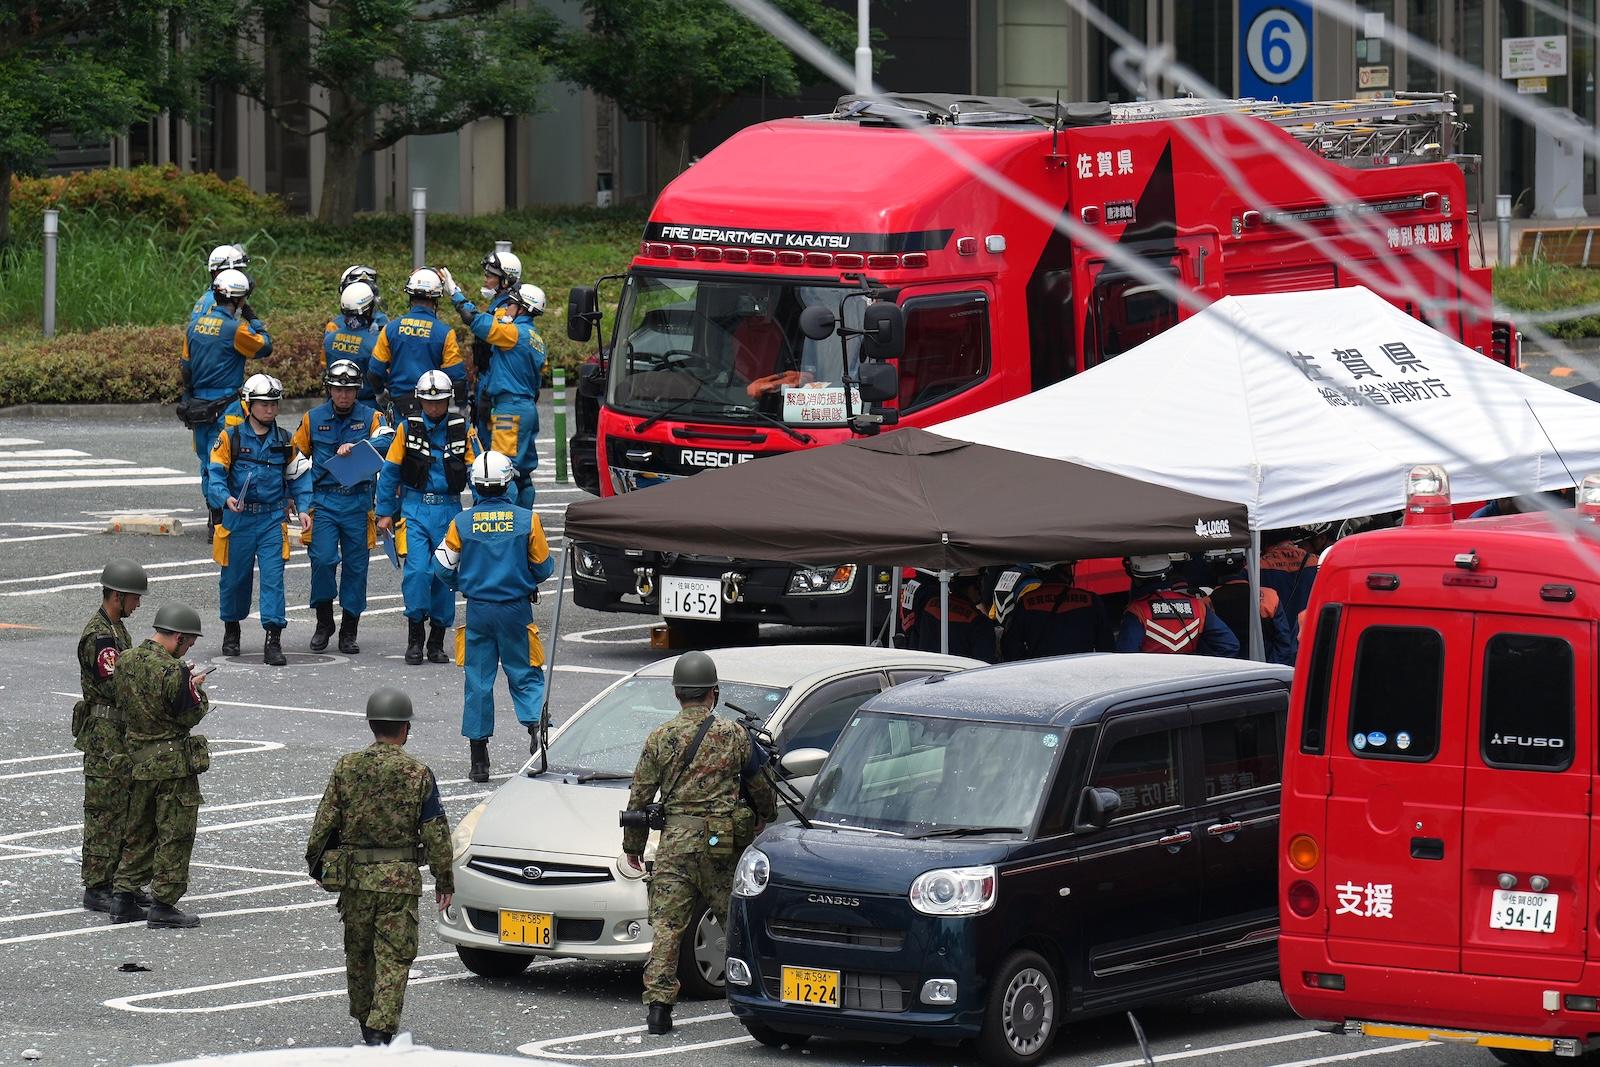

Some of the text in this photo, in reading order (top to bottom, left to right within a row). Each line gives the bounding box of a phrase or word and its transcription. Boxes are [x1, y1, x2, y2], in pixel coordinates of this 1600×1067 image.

[1261, 19, 1292, 74] 6
[1077, 150, 1134, 179] 佐賀県
[661, 226, 850, 248] FIRE DEPARTMENT KARATSU
[1387, 222, 1453, 248] 特別救助隊
[194, 325, 220, 336] POLICE
[398, 326, 431, 338] POLICE
[332, 342, 360, 354] POLICE
[1286, 341, 1430, 382] 佐賀県
[472, 521, 514, 533] POLICE
[1207, 519, 1229, 534] LOGOS
[675, 591, 717, 615] 16-52
[1503, 736, 1564, 748] FUSO
[807, 894, 860, 907] CANBUS
[1335, 881, 1393, 918] 支援
[1505, 907, 1552, 929] 94-14
[797, 983, 836, 1004] 12-24
